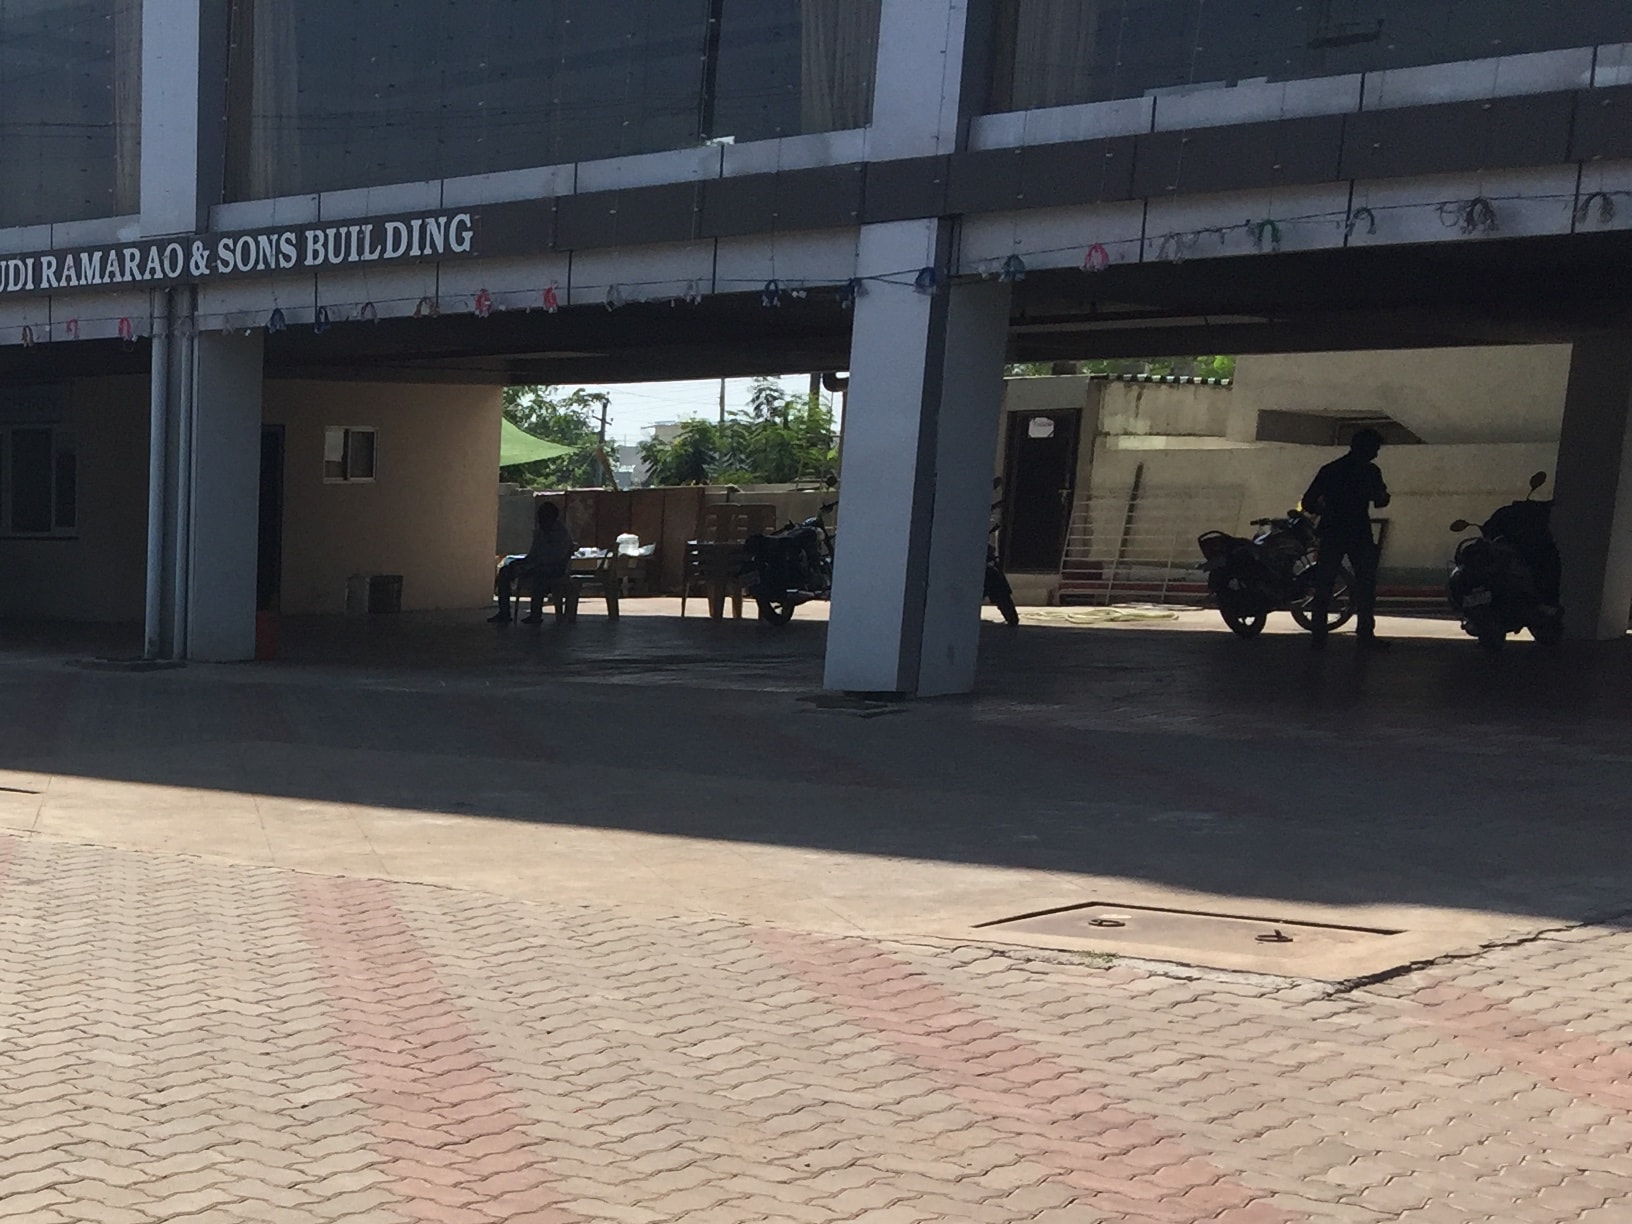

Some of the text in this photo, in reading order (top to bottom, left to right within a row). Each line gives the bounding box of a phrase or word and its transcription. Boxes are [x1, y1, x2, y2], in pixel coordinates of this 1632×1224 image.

[40, 242, 185, 289] RAMARAO
[189, 240, 211, 276] &
[217, 231, 298, 274] SONS
[304, 213, 474, 267] BUILDING
